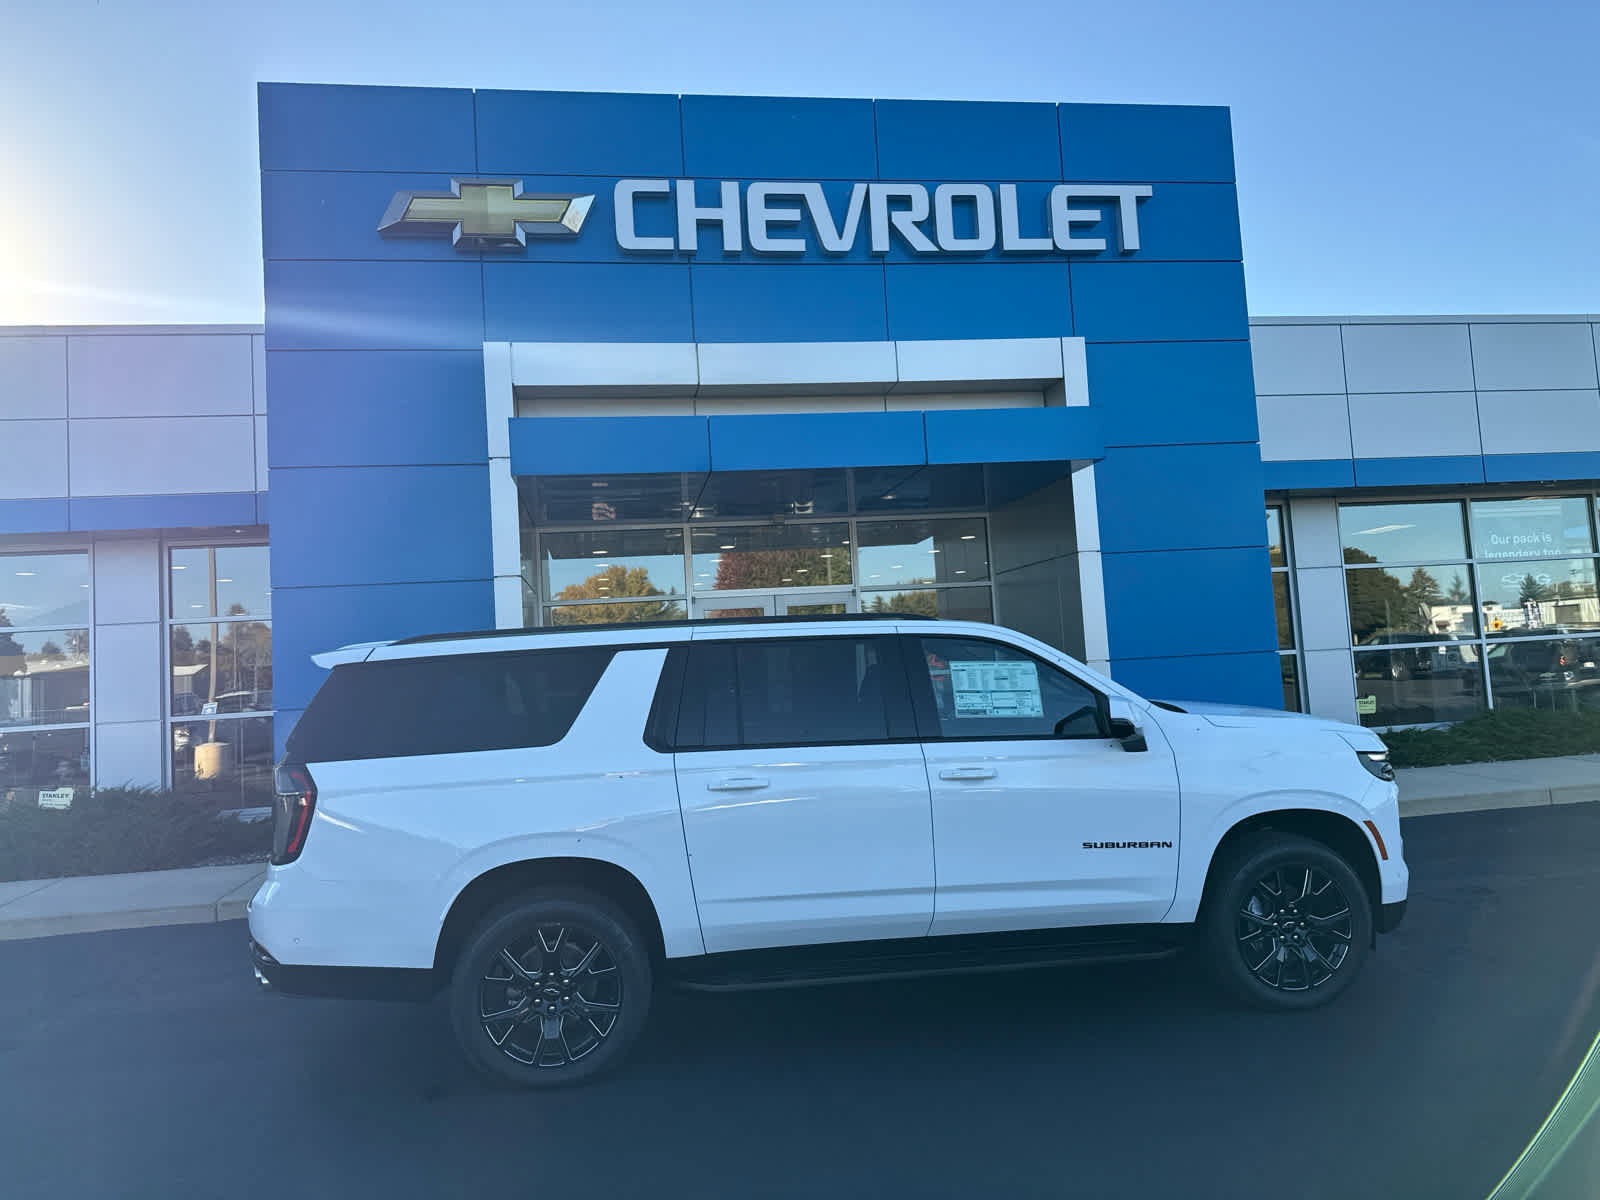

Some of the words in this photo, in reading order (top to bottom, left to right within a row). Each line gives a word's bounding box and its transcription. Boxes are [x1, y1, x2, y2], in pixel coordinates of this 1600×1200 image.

[613, 178, 1153, 255] CHEVROLET
[1490, 534, 1512, 545] Our
[1512, 532, 1540, 547] pack
[1542, 532, 1553, 545] is
[1082, 841, 1173, 849] SUBURBAN
